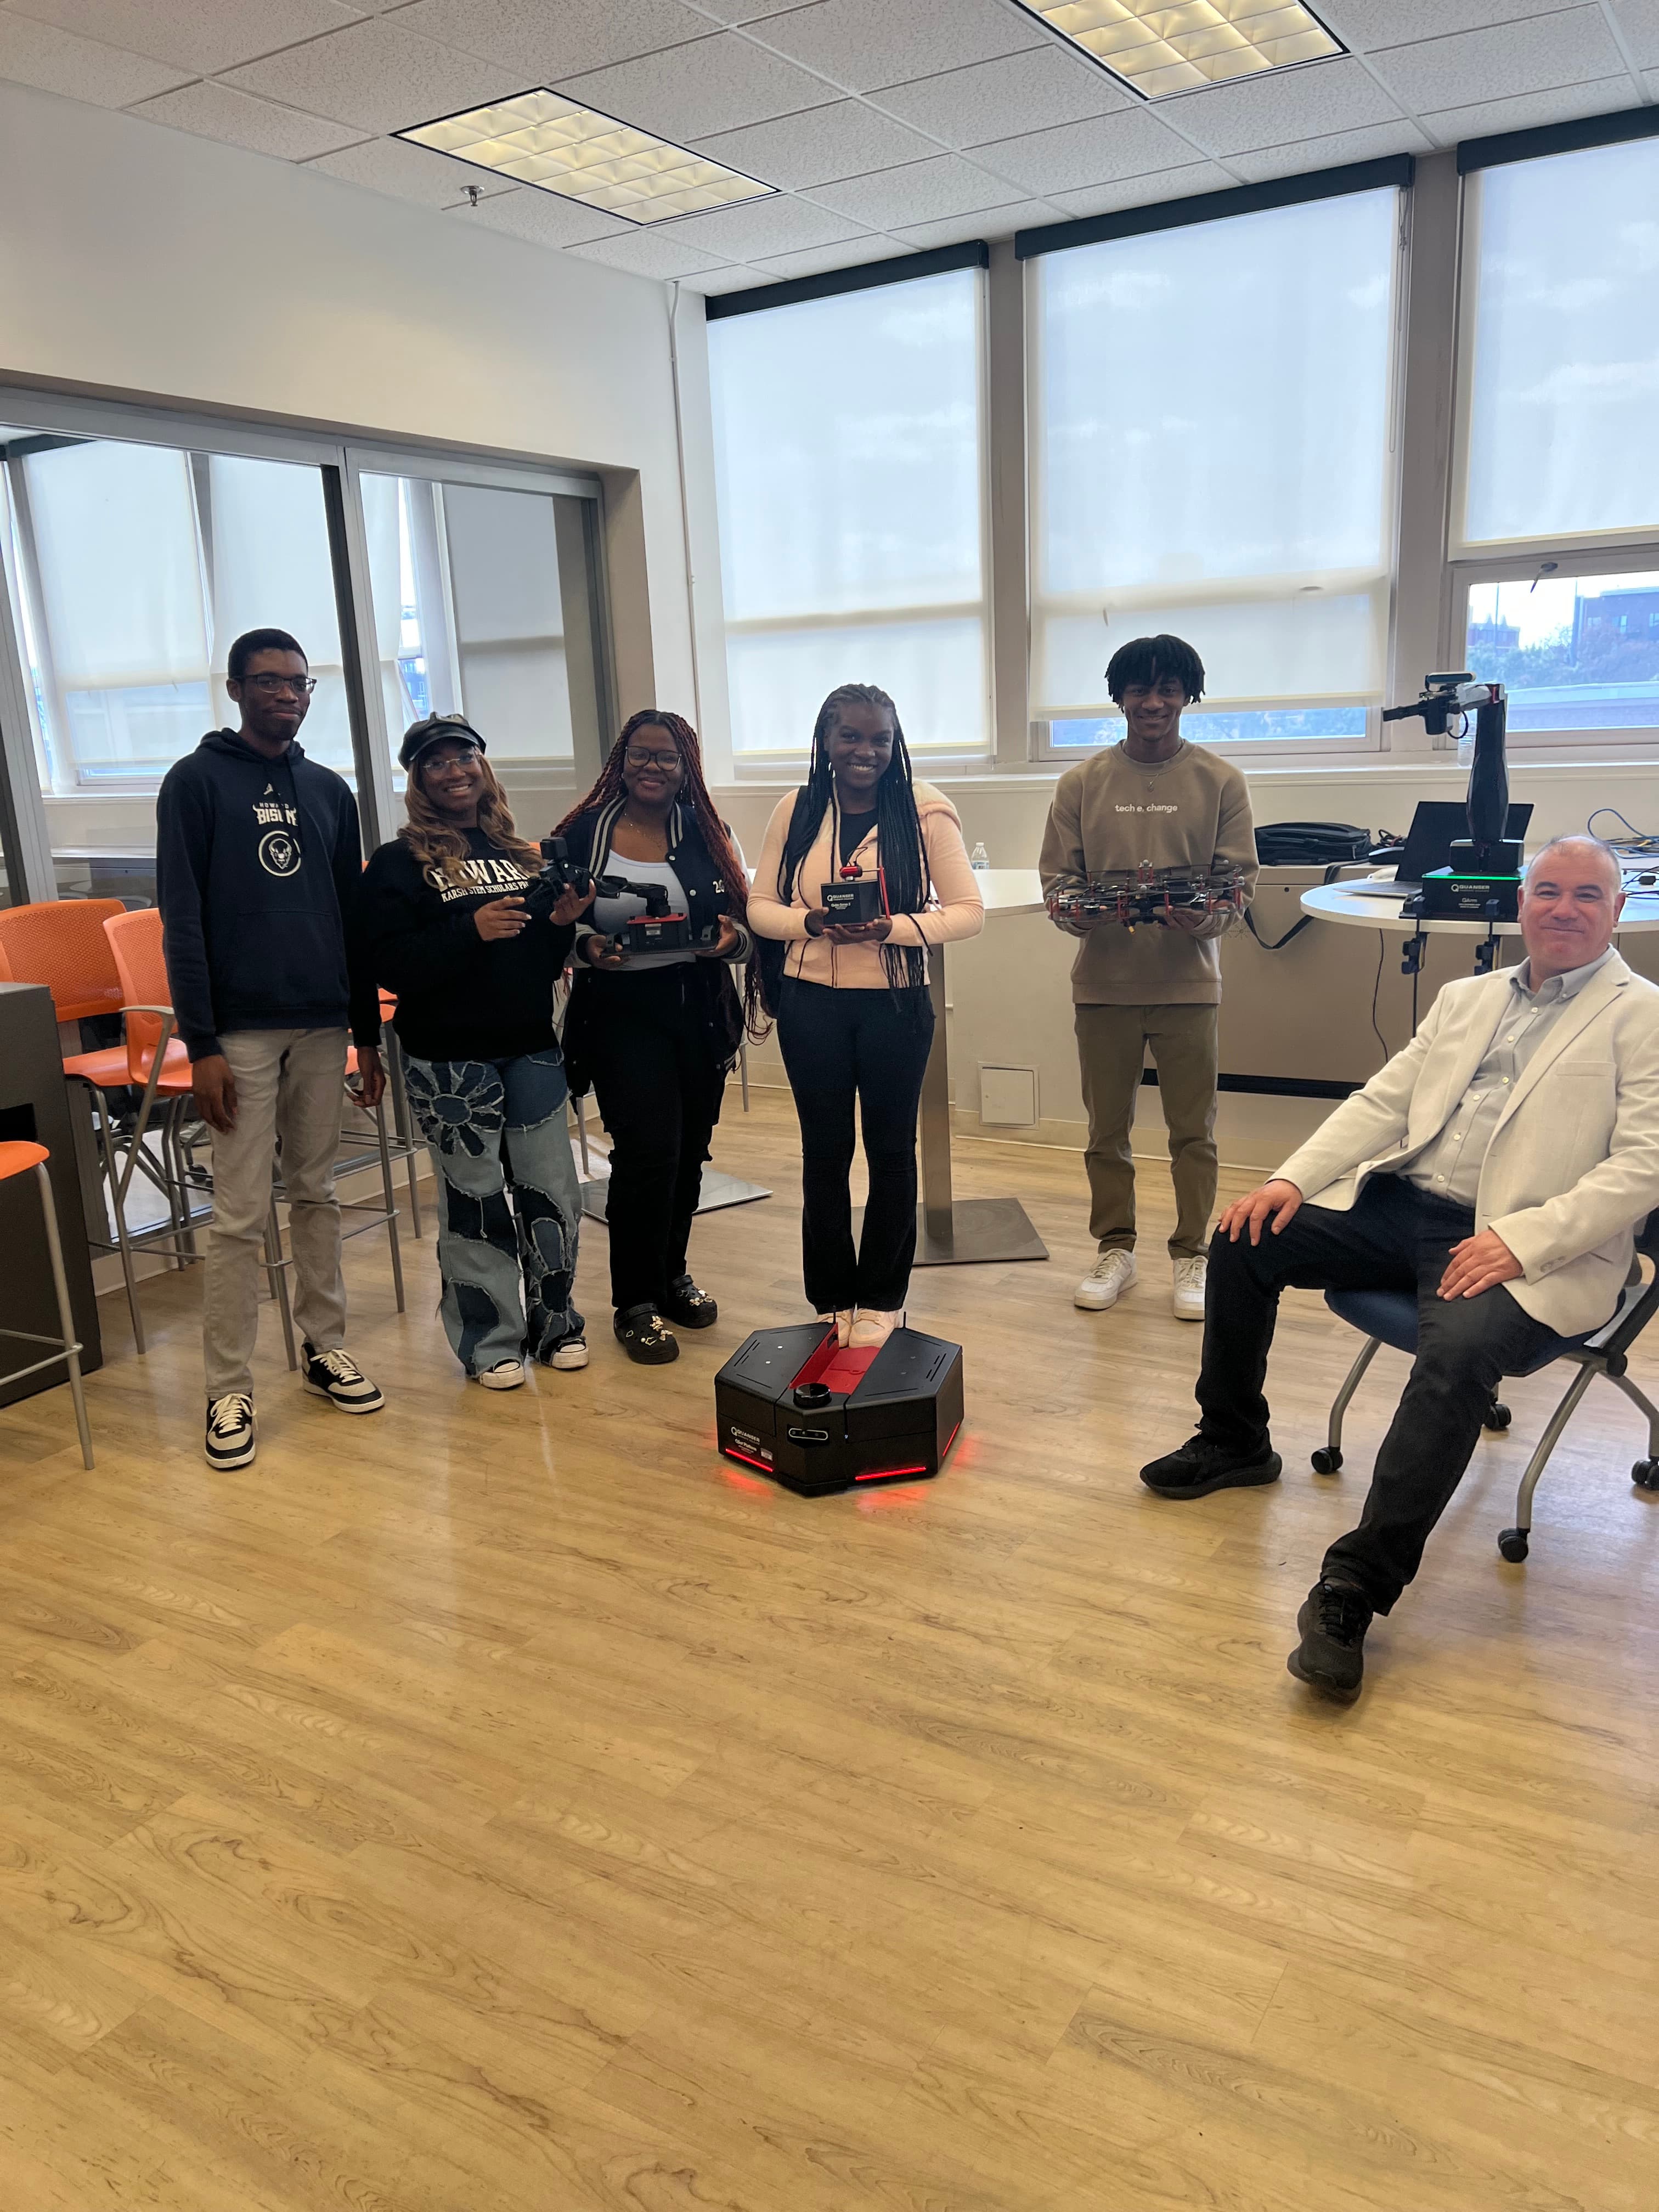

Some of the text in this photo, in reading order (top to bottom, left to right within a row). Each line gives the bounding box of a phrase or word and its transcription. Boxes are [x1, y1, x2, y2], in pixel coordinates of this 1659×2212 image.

[1115, 803, 1135, 812] tech
[441, 888, 469, 902] KARSH
[469, 885, 487, 894] STEM
[484, 882, 519, 894] SCHOLARS
